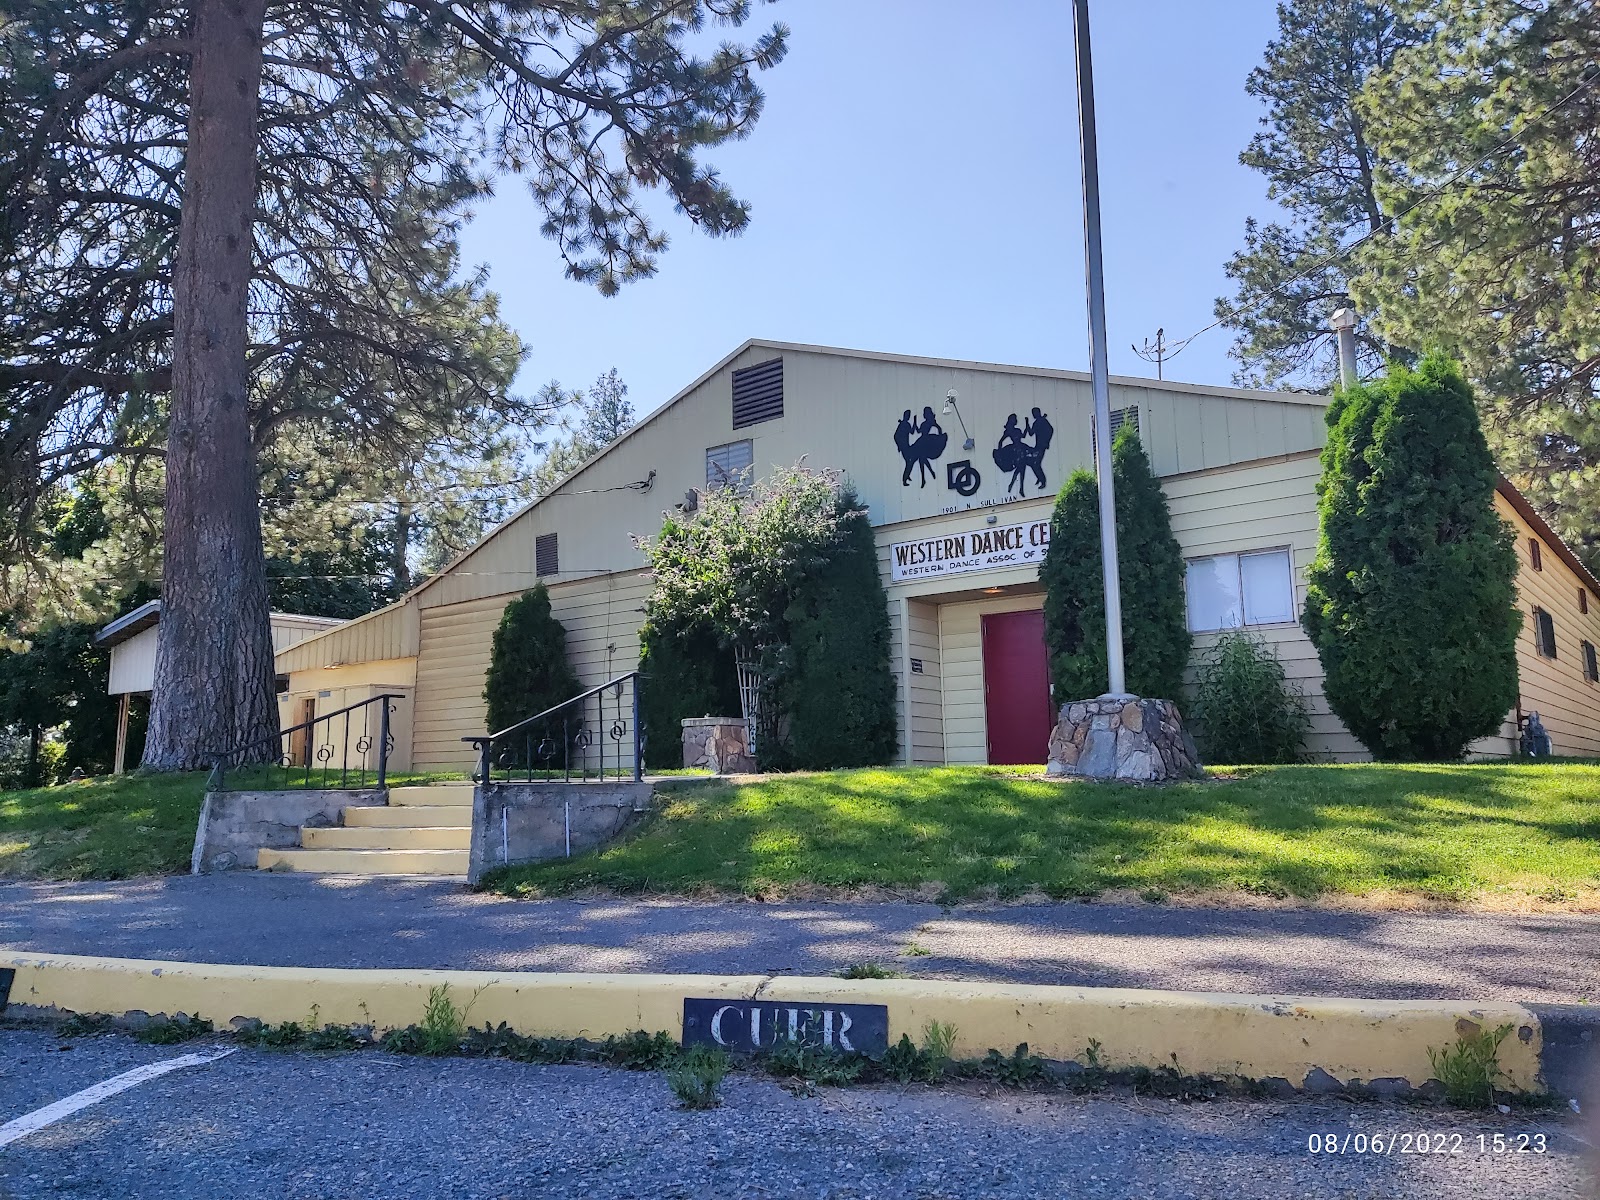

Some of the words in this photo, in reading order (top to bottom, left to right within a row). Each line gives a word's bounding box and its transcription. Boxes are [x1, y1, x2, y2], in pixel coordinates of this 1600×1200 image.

[942, 506, 957, 514] 1901
[895, 536, 965, 566] WESTERN
[971, 526, 1024, 556] DANCE
[901, 564, 944, 576] WESTERN
[949, 559, 980, 569] DANCE
[1023, 550, 1035, 559] OF
